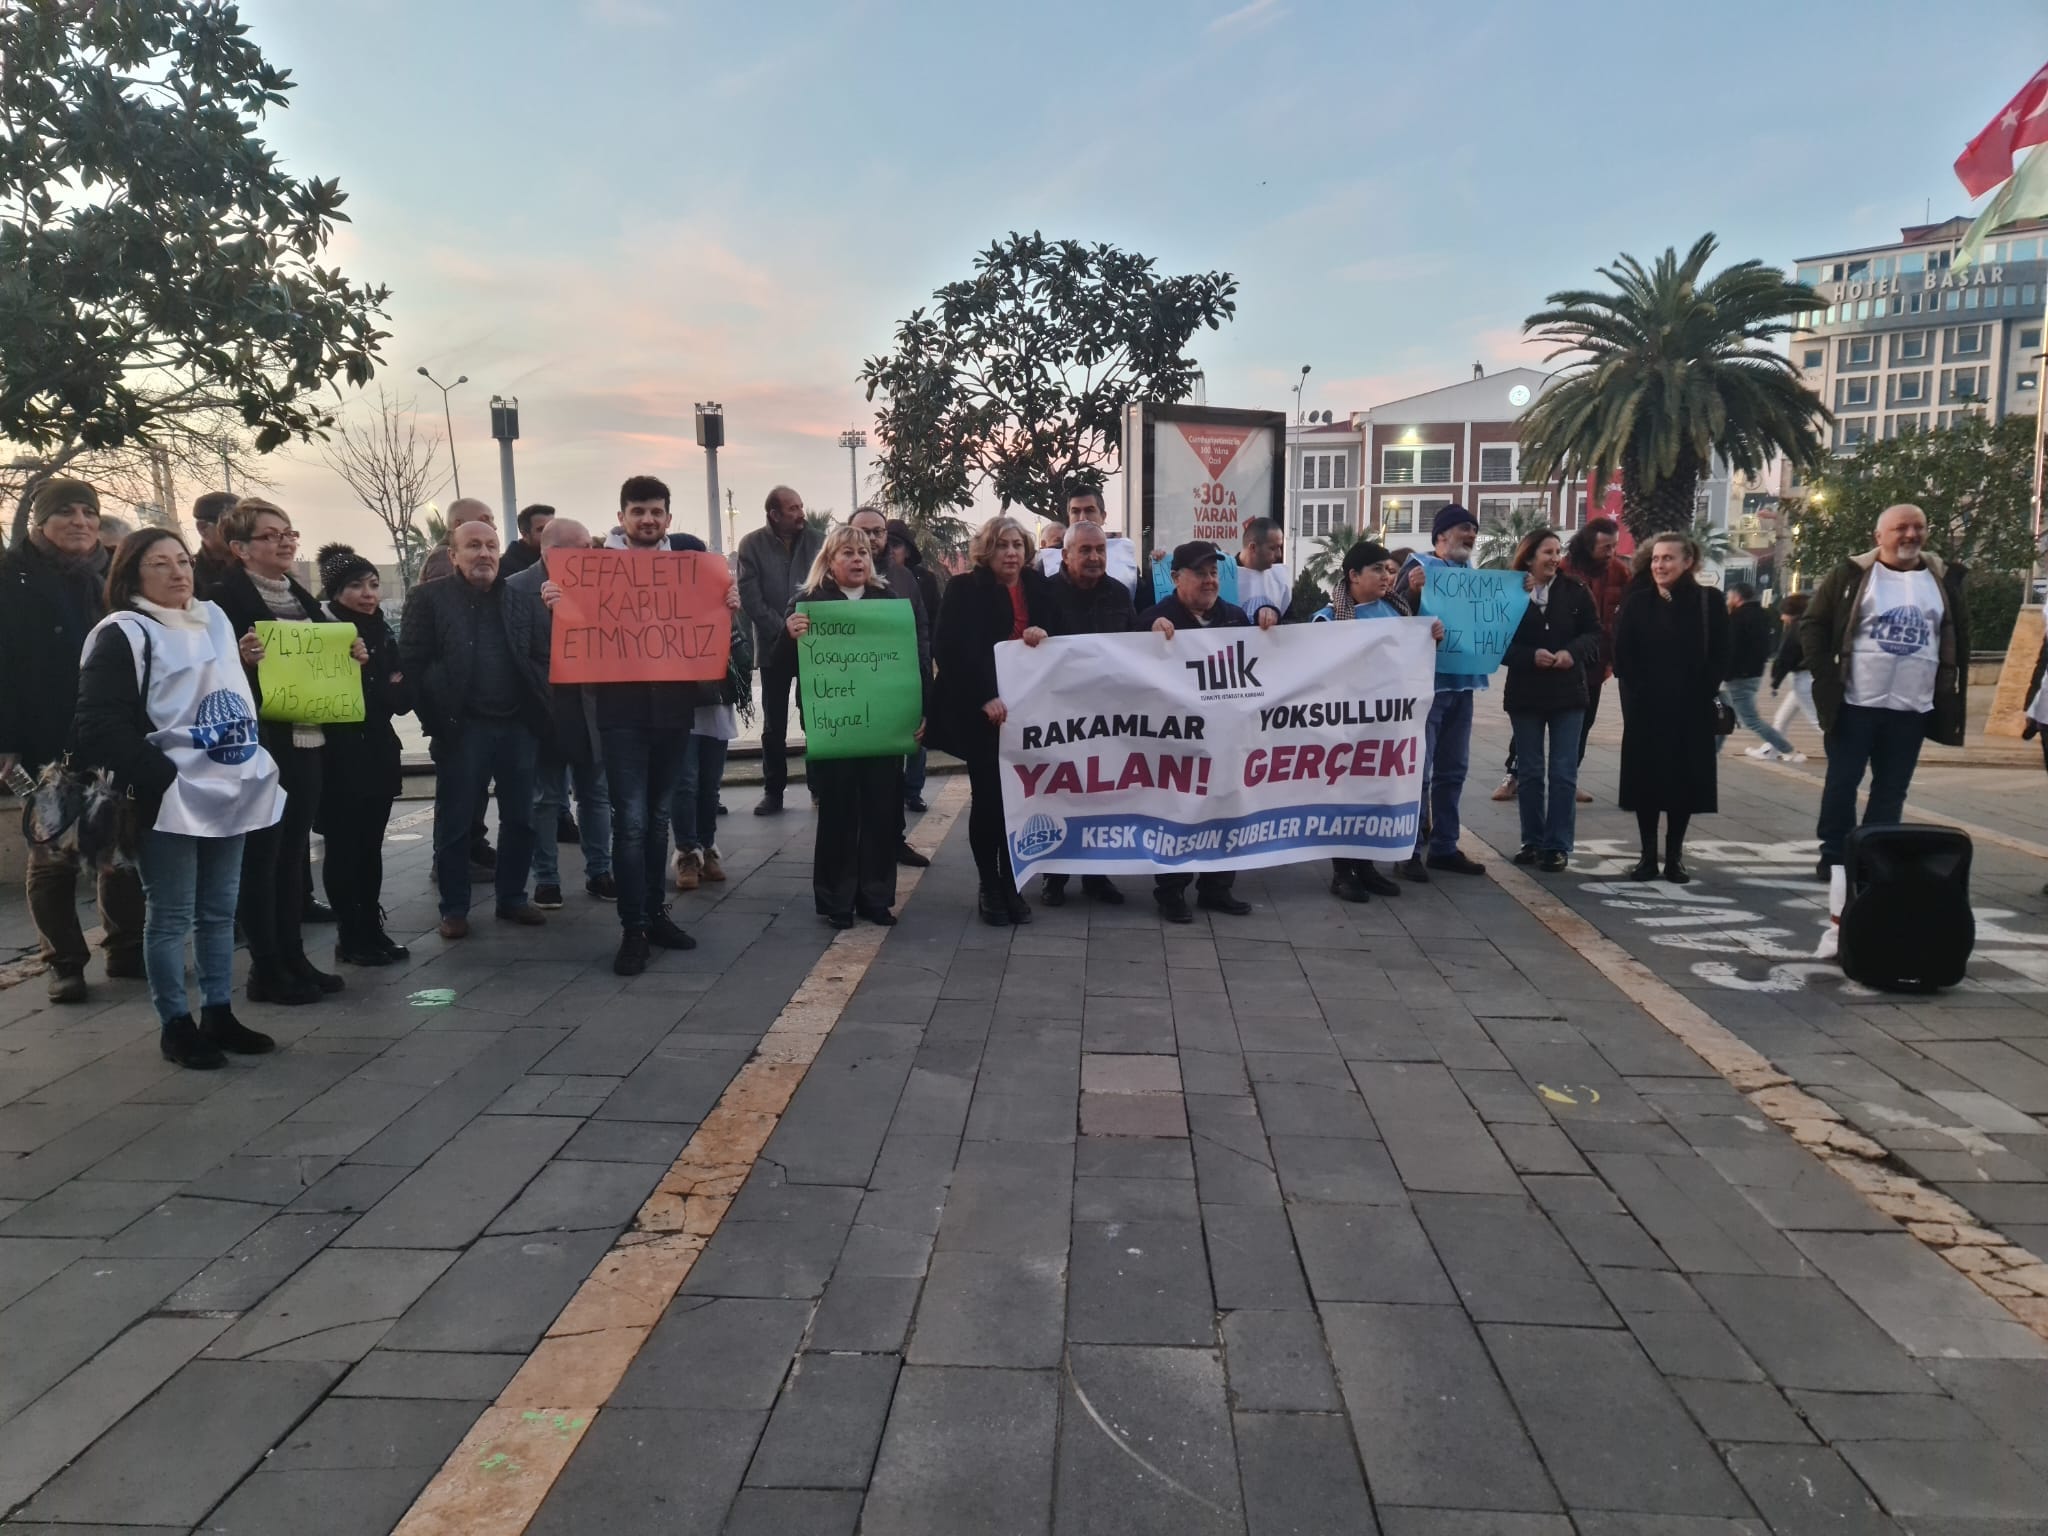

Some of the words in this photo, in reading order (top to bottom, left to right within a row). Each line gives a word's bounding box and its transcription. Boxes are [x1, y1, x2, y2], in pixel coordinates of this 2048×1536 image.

[1834, 274, 1900, 300] HOTEL
[1924, 266, 2003, 291] BAŞAR
[1194, 507, 1238, 523] VARAN
[1433, 572, 1507, 599] KORKMA
[598, 590, 693, 623] KABUL
[1869, 622, 1930, 647] KESK
[814, 673, 857, 699] Ücret
[1022, 714, 1205, 750] RAKAMLAR
[1013, 752, 1212, 799] YALAN!
[1243, 736, 1417, 788] GERÇEK!
[1017, 828, 1063, 854] KESK
[1081, 825, 1138, 849] KESK
[1142, 825, 1222, 857] GİRESUN
[1225, 816, 1301, 852] ŞUBELER
[1304, 813, 1415, 838] PLATFORMU
